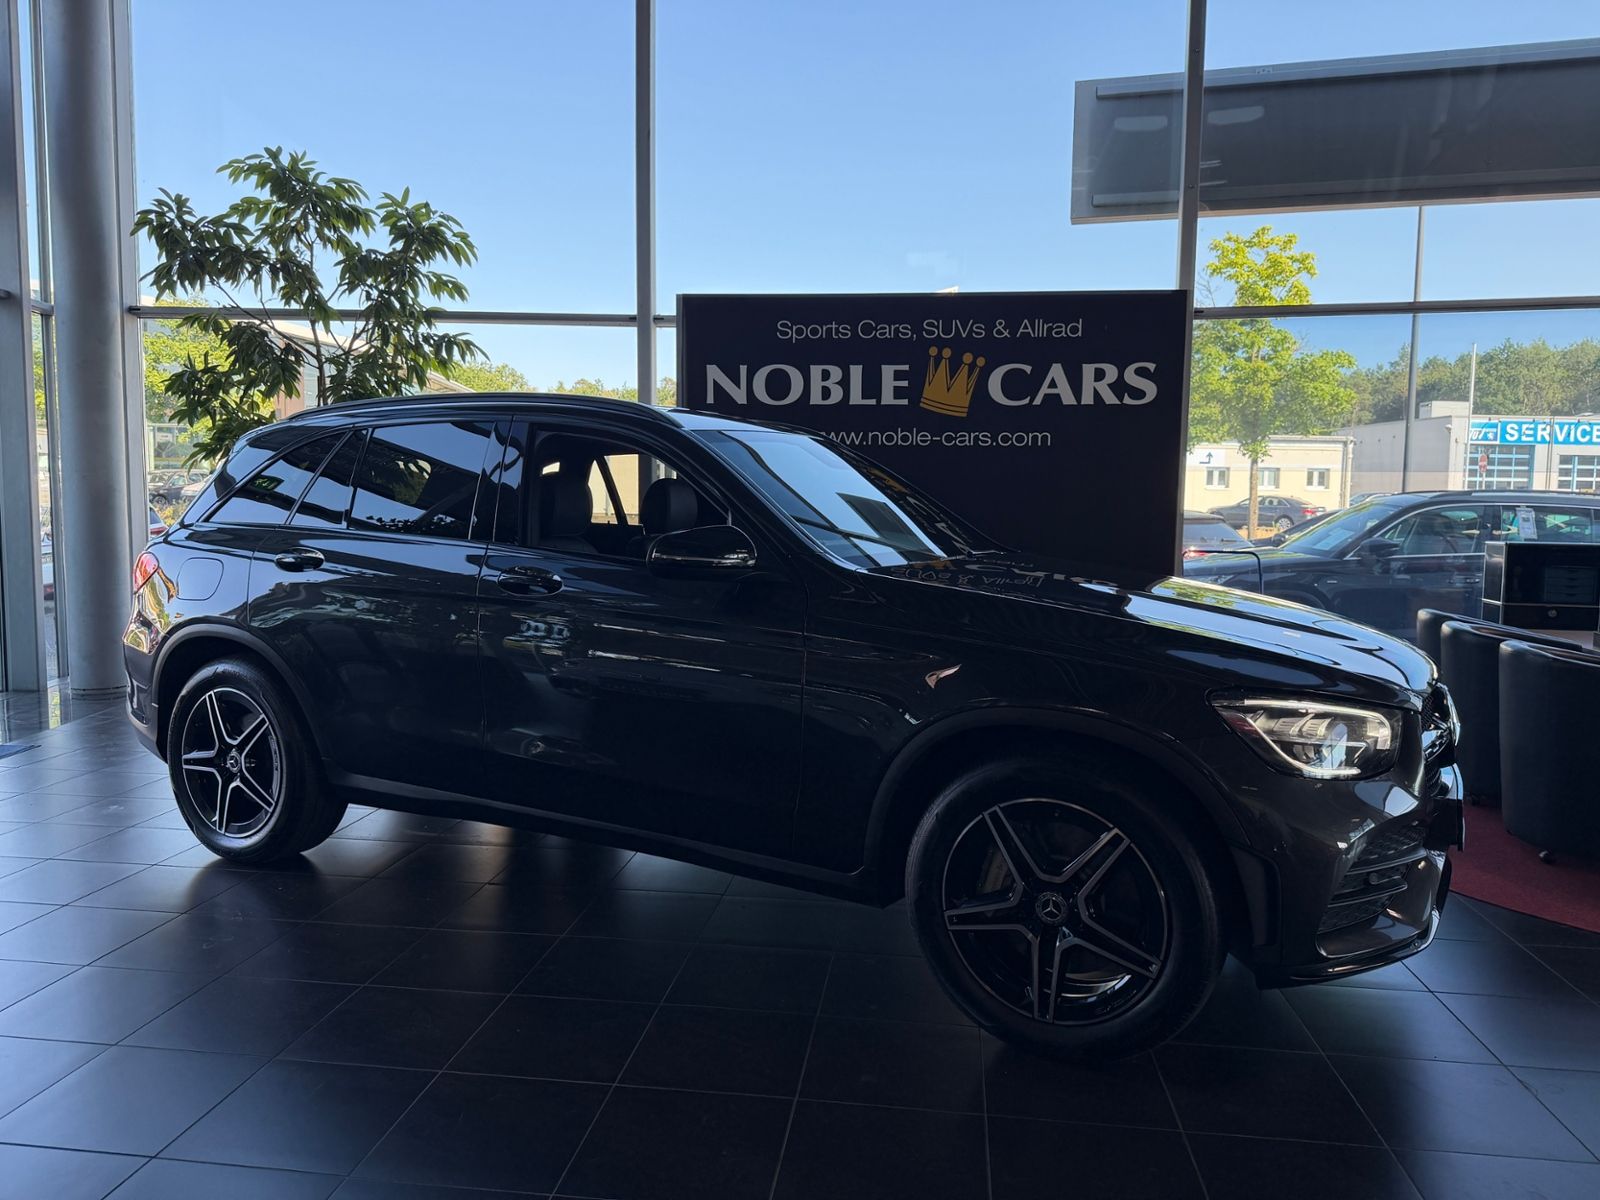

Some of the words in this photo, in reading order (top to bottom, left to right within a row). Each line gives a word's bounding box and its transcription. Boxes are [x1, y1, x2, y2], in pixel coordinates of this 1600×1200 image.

[776, 320, 851, 344] Sports
[857, 319, 917, 341] Cars,
[922, 319, 986, 338] SUVs
[992, 319, 1011, 338] &
[1016, 318, 1083, 338] Allrad
[705, 363, 910, 406] NOBLE
[987, 362, 1158, 406] CARS
[819, 427, 1051, 447] ww.noble-cars.com
[1505, 423, 1600, 443] SERVICE
